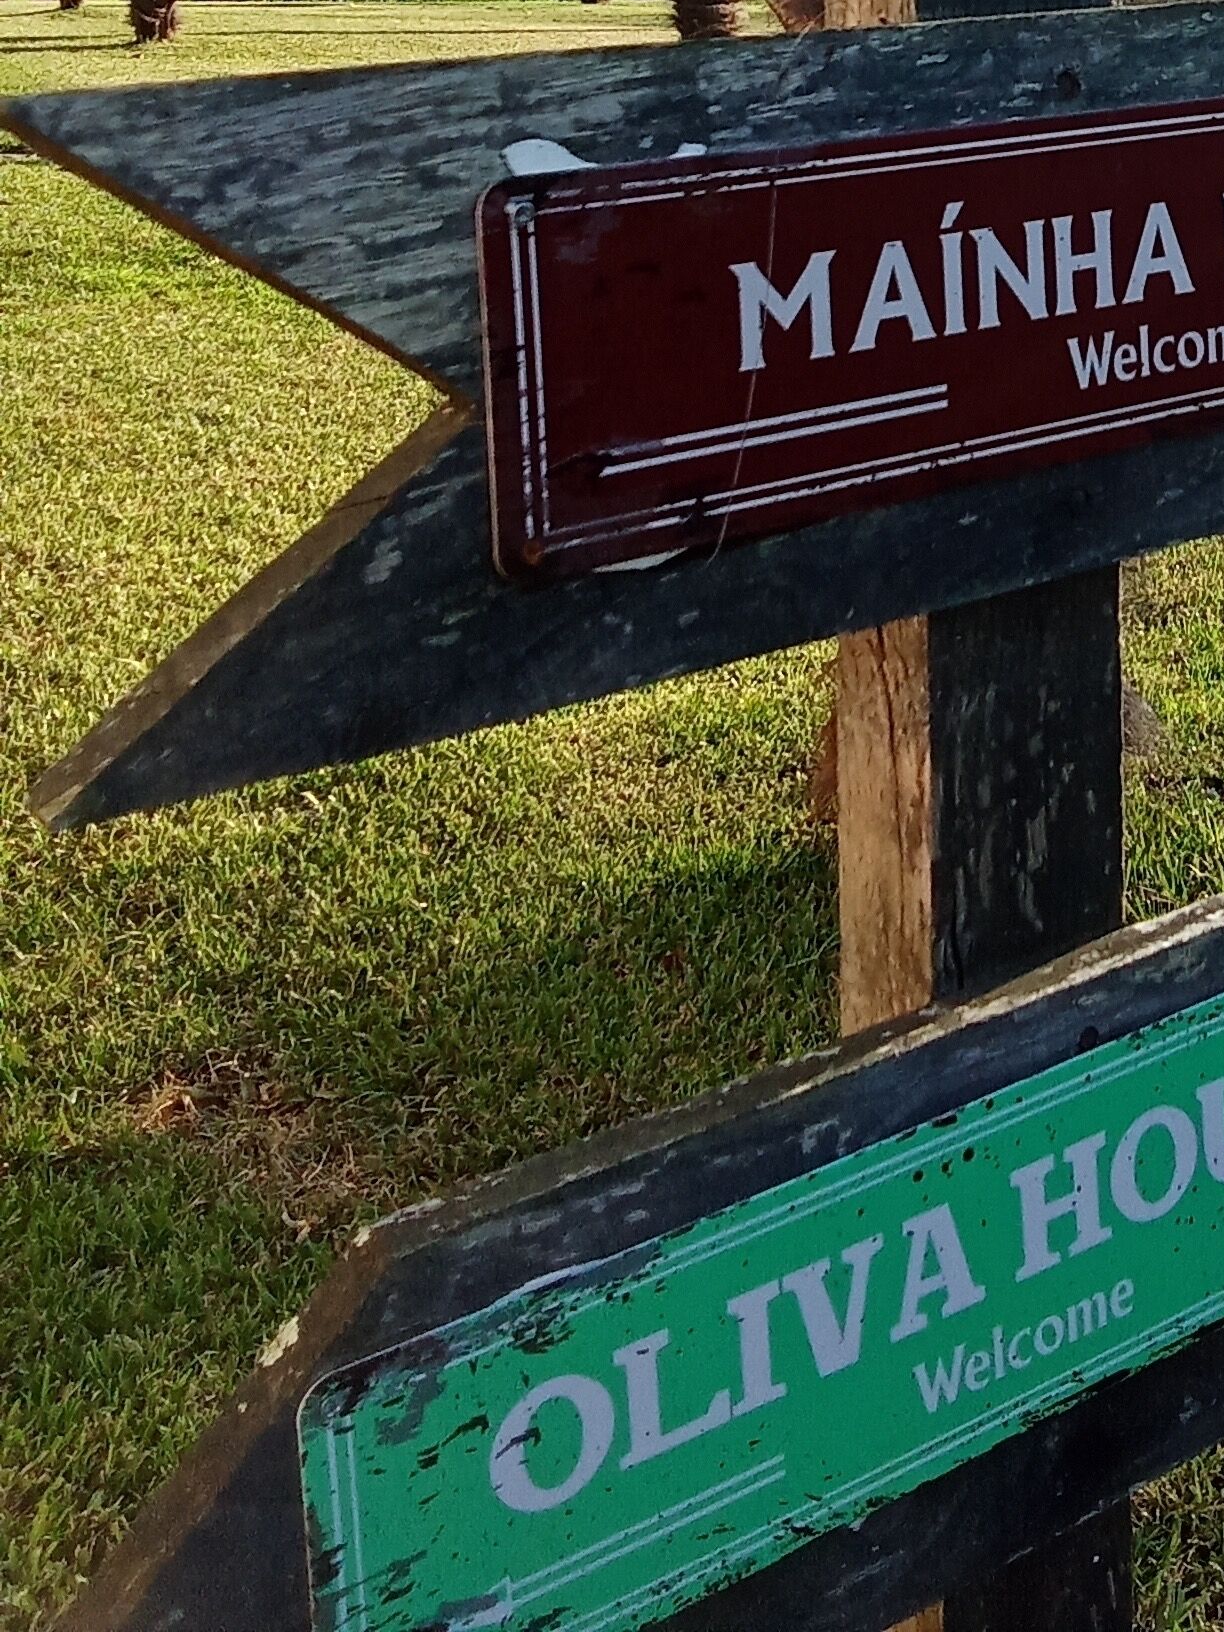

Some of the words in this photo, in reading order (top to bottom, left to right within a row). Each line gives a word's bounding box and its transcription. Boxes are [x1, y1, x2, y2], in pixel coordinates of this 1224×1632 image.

[729, 201, 1196, 374] MAÍNHA
[489, 1202, 986, 1513] OLIVA
[913, 1277, 1136, 1415] Welcome
